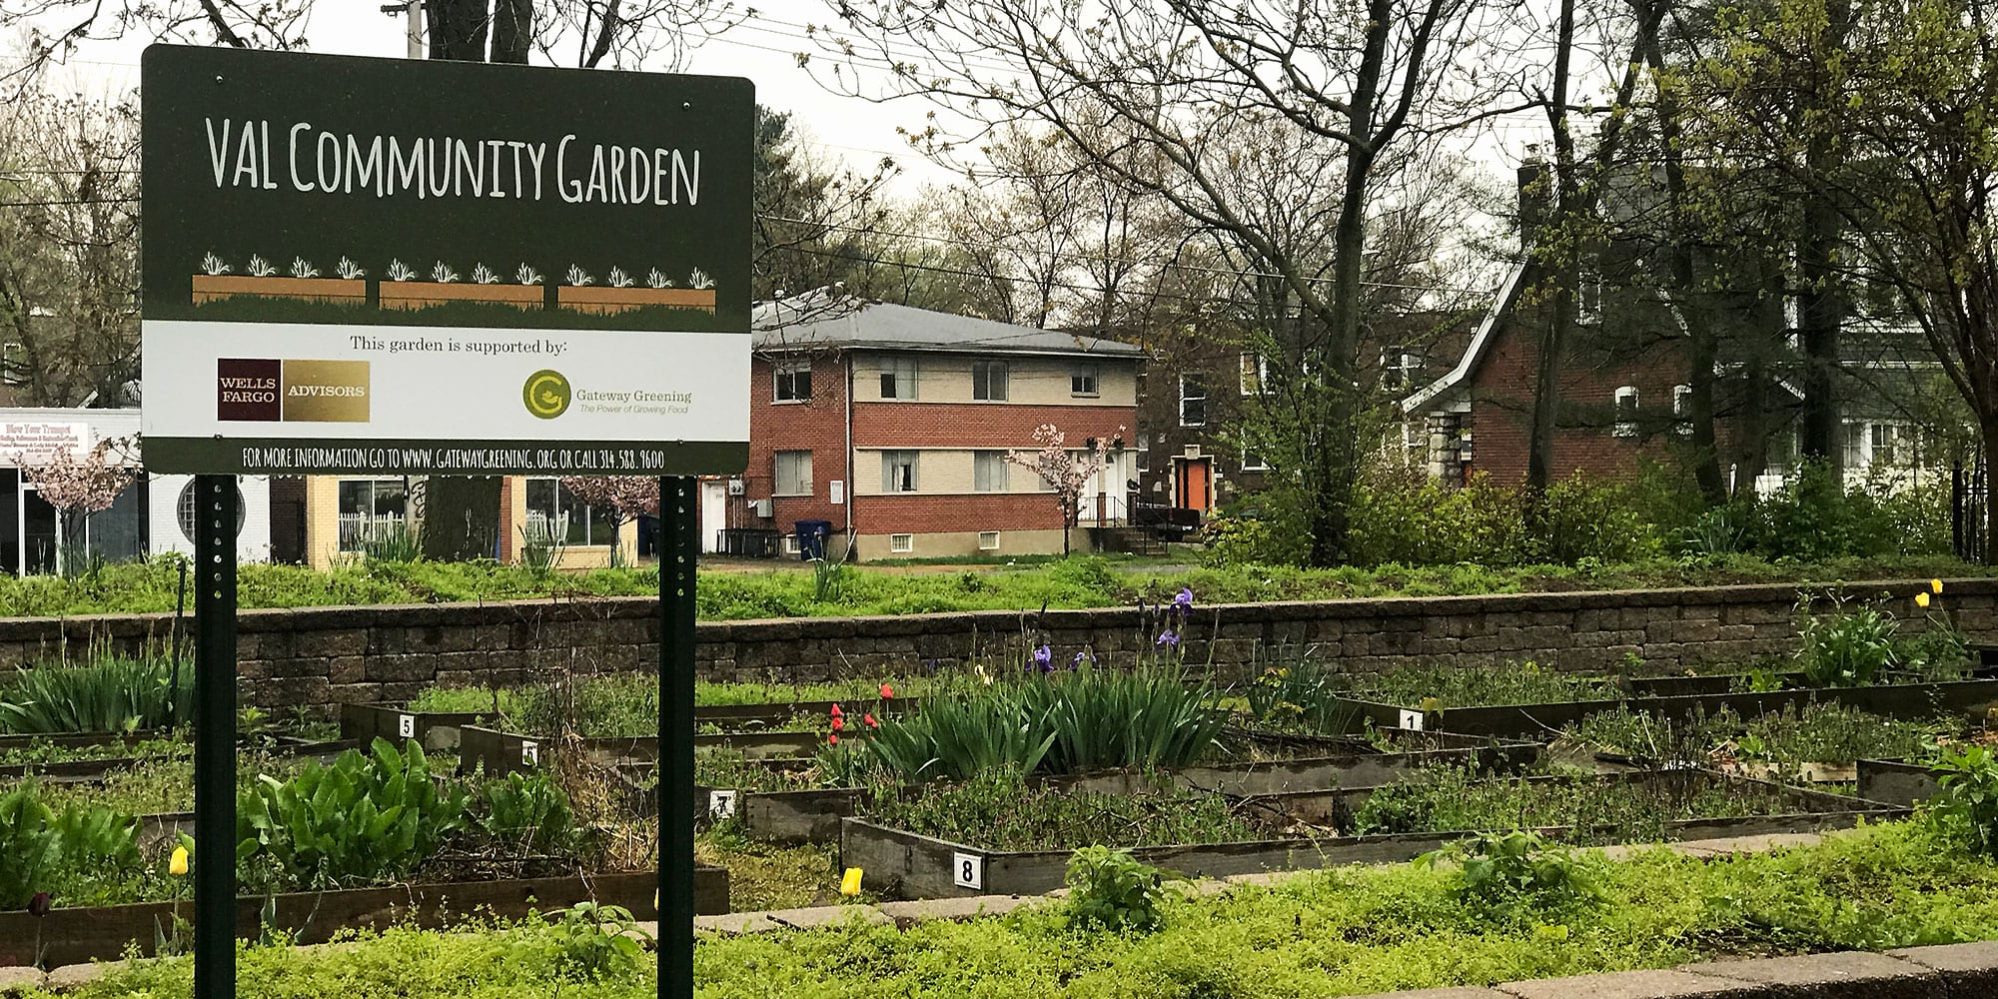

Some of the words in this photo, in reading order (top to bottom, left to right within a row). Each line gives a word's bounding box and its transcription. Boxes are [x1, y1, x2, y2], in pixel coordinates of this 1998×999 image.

[206, 118, 277, 189] VAL
[350, 335, 385, 350] This
[389, 337, 443, 353] garden
[448, 337, 460, 351] is
[465, 339, 540, 356] supported
[545, 339, 567, 356] by:
[220, 378, 276, 389] WELLS
[222, 392, 275, 403] FARGO
[288, 385, 365, 397] ADVISORS
[576, 389, 631, 403] Gateway
[633, 391, 693, 403] Greening
[580, 404, 595, 413] The
[597, 405, 622, 413] Power
[624, 405, 632, 413] of
[633, 406, 666, 415] Growing
[668, 406, 689, 414] Food
[243, 447, 262, 467] FOR
[264, 447, 293, 468] MORE
[295, 448, 368, 468] INFORMATION
[369, 448, 385, 468] GO
[387, 449, 400, 469] TO
[402, 449, 558, 469] WWW.GATEWAYGREENING.ORG
[559, 450, 573, 469] OR
[575, 450, 597, 469] CALL
[600, 450, 665, 470] 314.588.9600
[402, 719, 411, 734] 5
[1406, 715, 1415, 729] 1
[962, 860, 973, 883] 8
